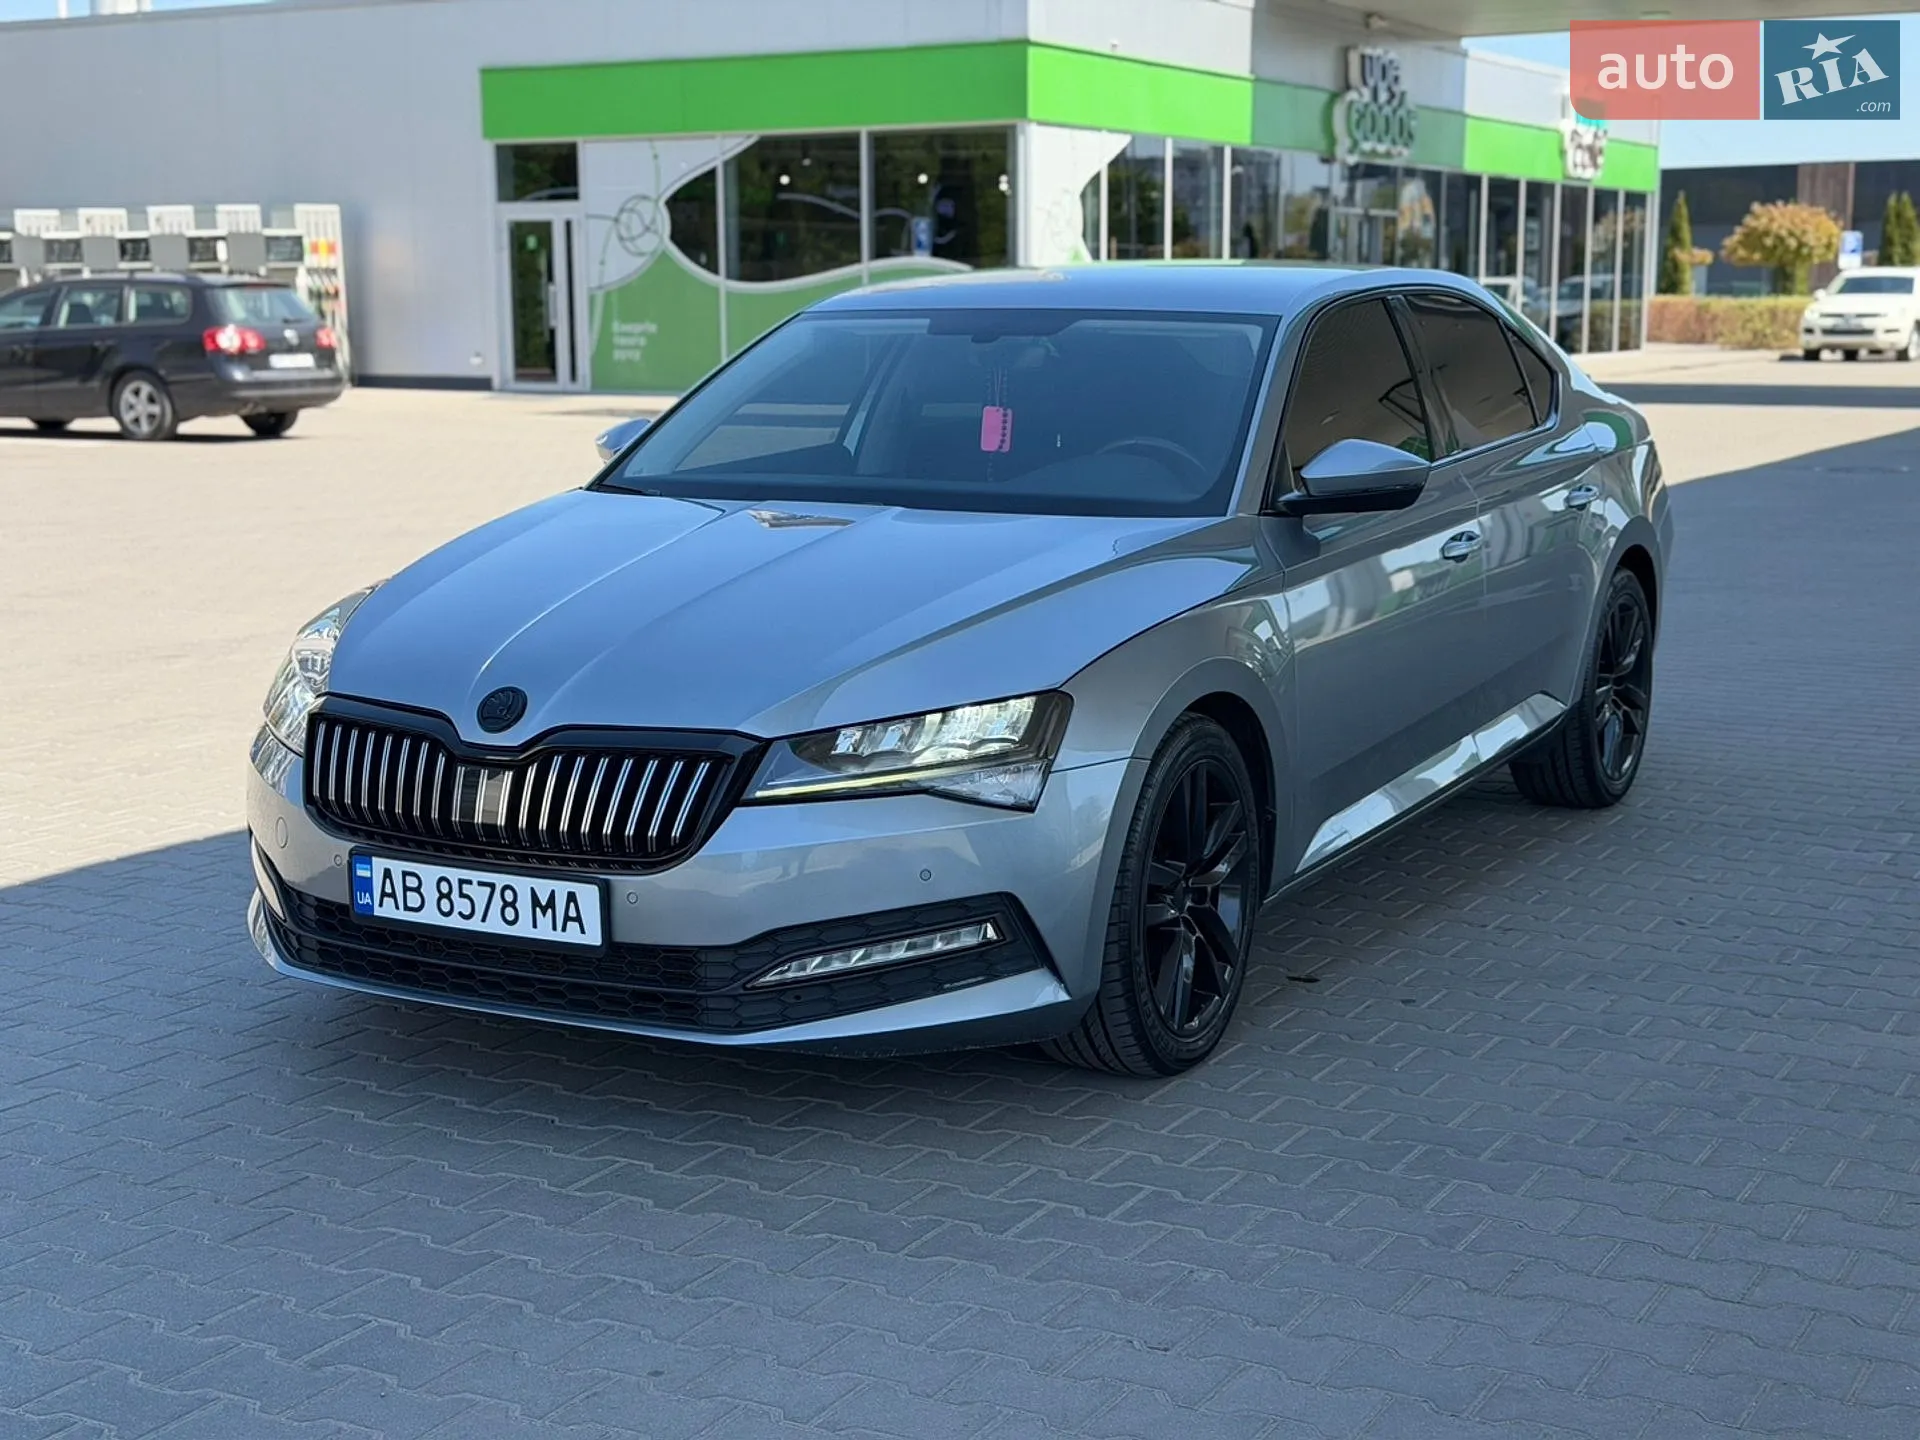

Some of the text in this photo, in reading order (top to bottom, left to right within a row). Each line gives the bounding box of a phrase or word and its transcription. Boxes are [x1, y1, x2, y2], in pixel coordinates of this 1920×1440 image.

[356, 891, 373, 906] UA
[378, 867, 587, 935] AB 8578 MA
